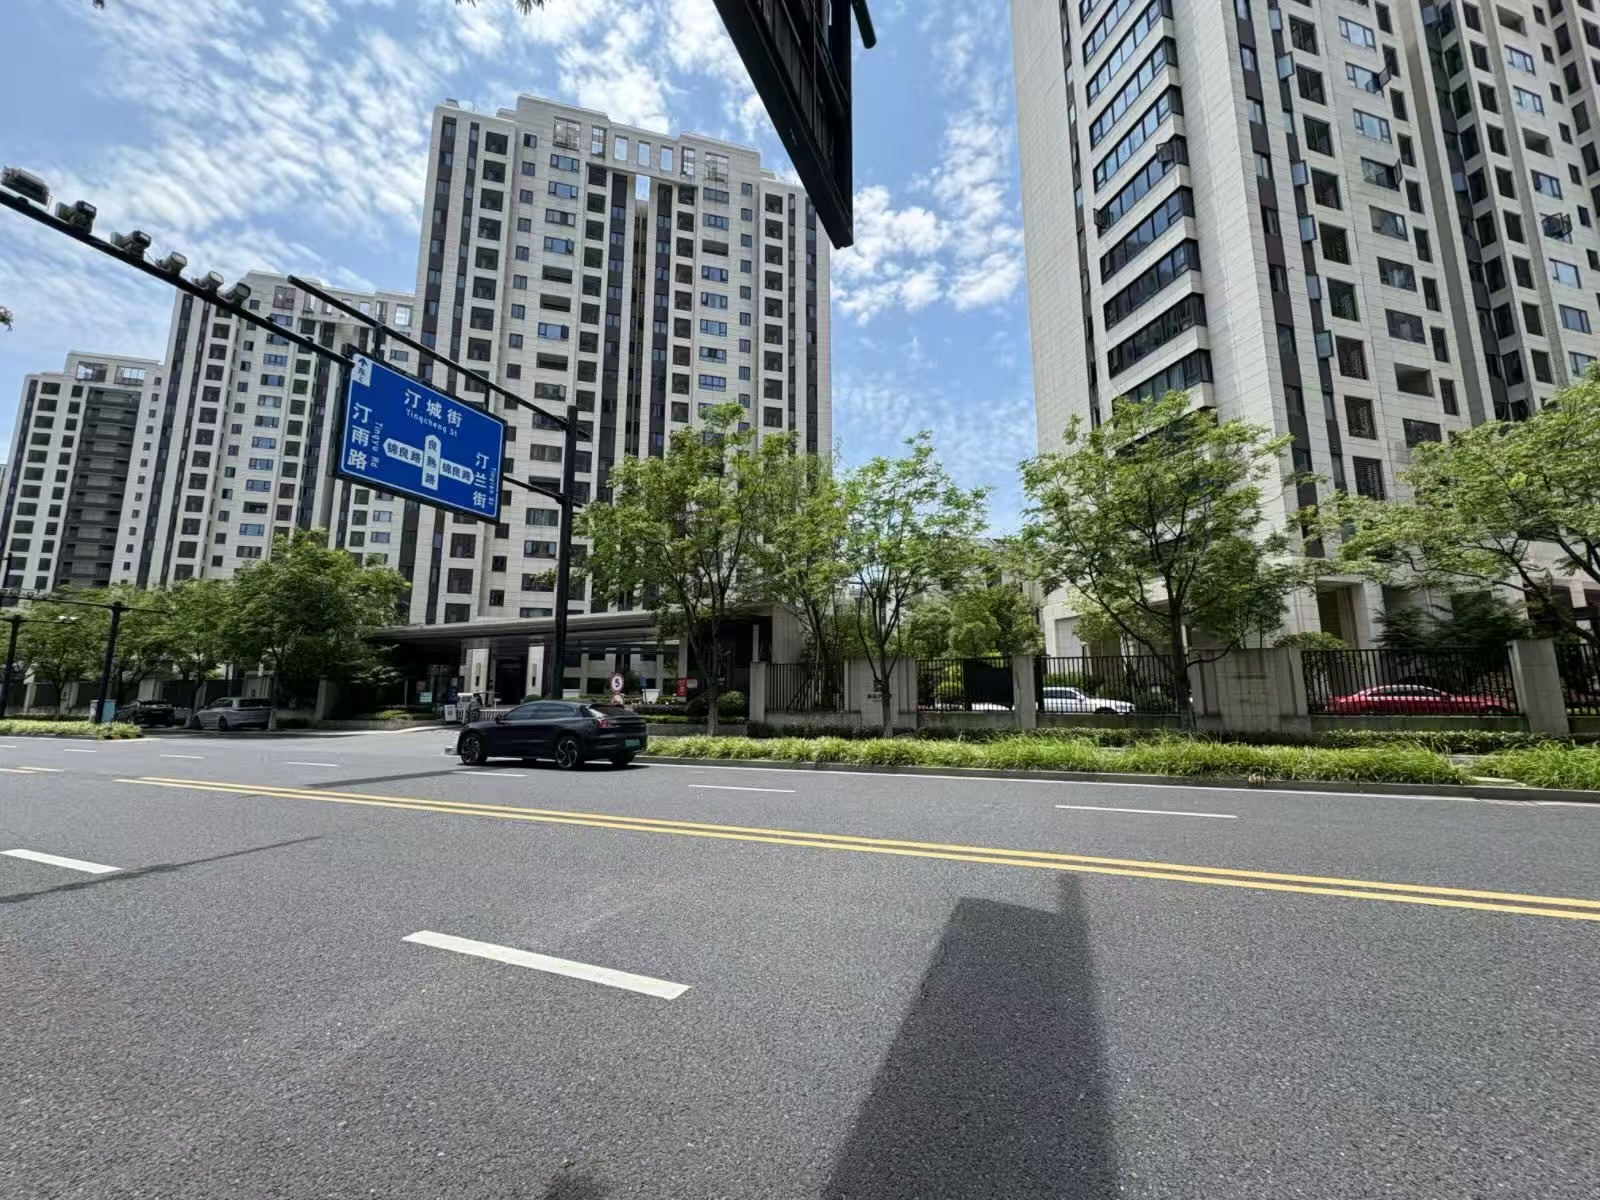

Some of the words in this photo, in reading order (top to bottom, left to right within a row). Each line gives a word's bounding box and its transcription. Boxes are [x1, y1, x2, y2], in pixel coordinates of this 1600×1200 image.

[404, 388, 463, 428] 汀城街
[405, 408, 447, 433] Tingcheng
[347, 402, 373, 472] 汀雨路
[371, 422, 383, 452] Tingyu
[370, 456, 380, 468] Rd
[386, 442, 422, 464] 锦良路
[441, 462, 472, 482] 锦良路
[472, 452, 490, 509] 汀兰街
[614, 678, 620, 688] 5
